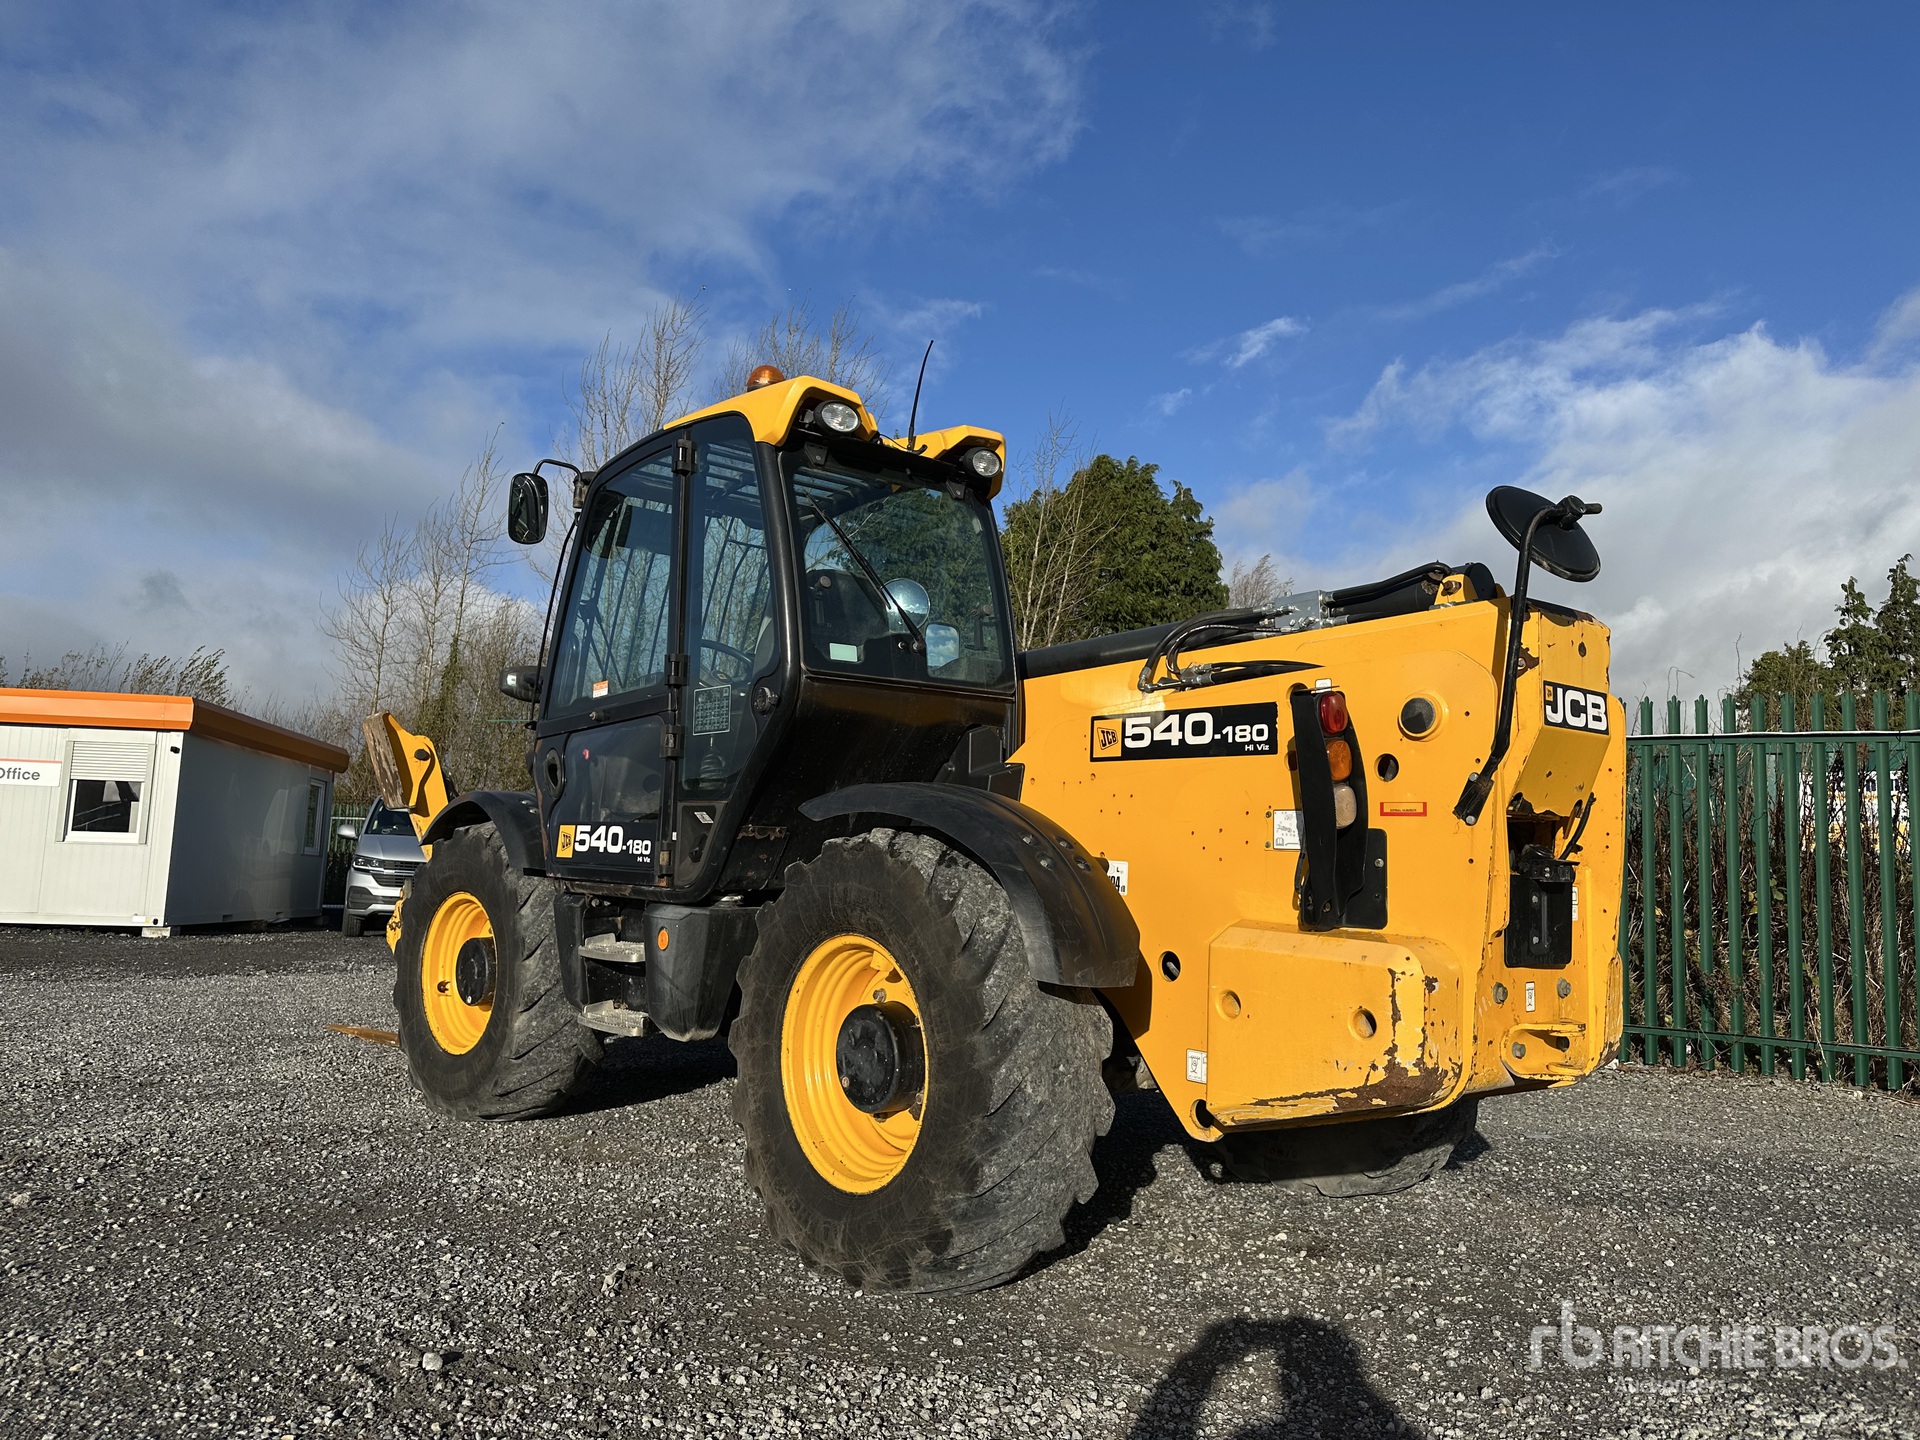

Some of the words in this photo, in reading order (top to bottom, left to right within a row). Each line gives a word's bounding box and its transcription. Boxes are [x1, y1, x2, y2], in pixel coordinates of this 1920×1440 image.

[1545, 687, 1608, 731] JCB
[1099, 729, 1118, 748] JCB
[1124, 712, 1269, 749] 540-180
[1244, 743, 1254, 751] Hi
[1256, 743, 1270, 751] Viz
[561, 832, 572, 850] JCB
[574, 824, 652, 855] 540-180
